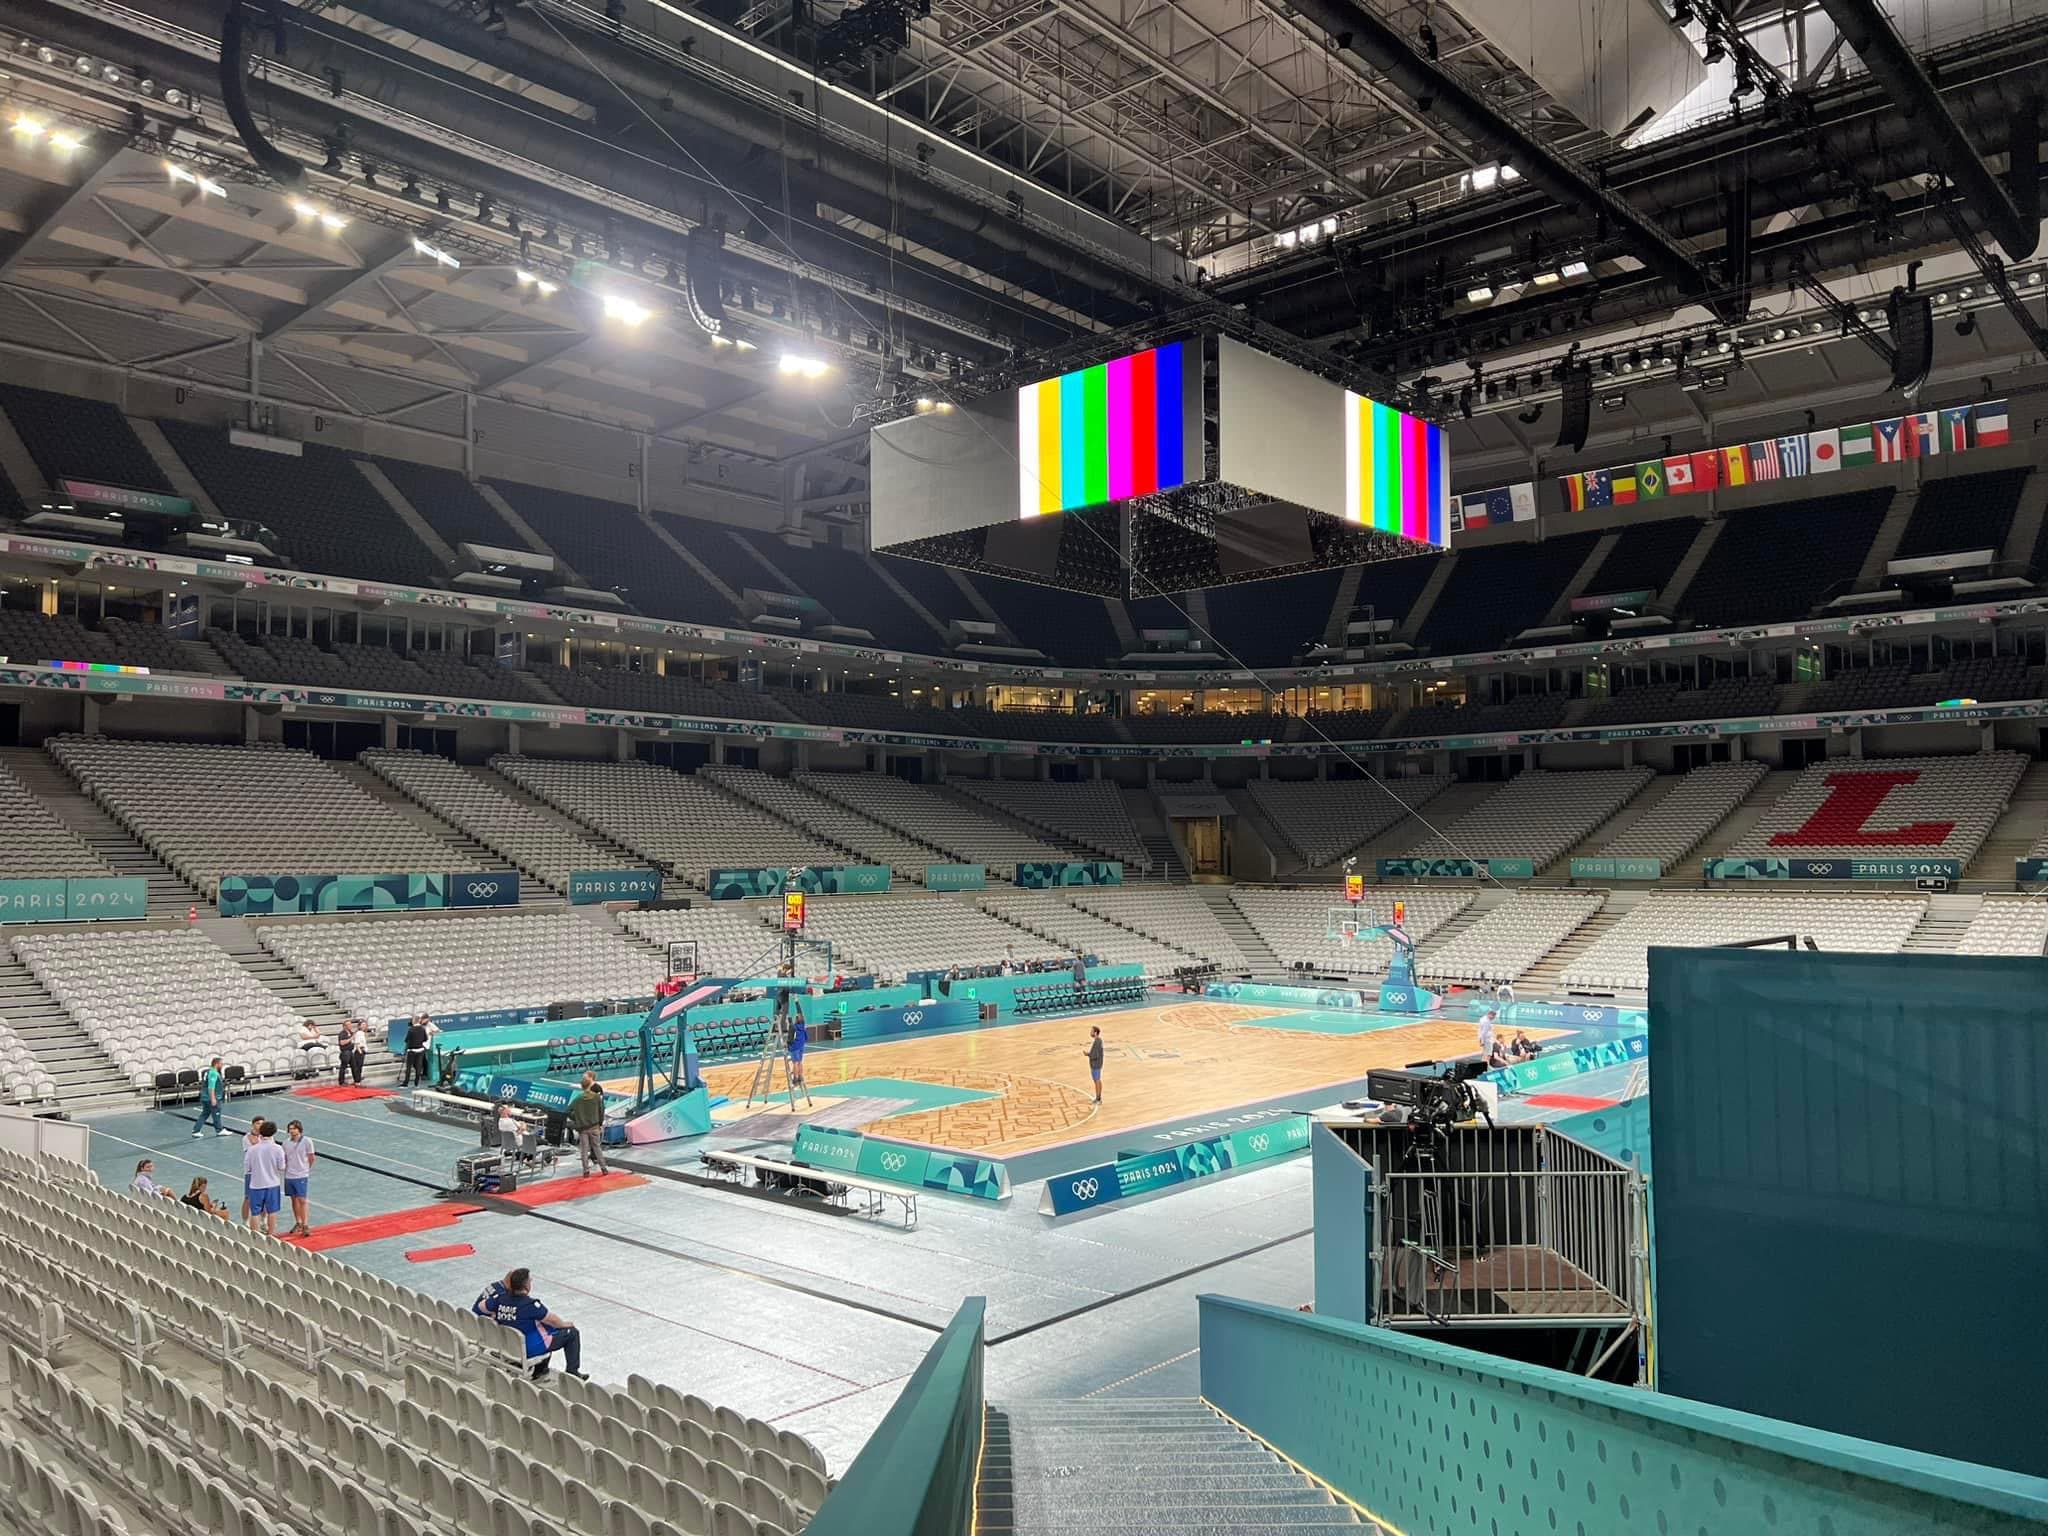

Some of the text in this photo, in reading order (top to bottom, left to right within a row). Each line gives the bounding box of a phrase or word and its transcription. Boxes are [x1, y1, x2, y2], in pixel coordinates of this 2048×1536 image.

[147, 684, 213, 697] PARIS 2024
[357, 697, 412, 709] PARIS 2024
[1933, 709, 1989, 719] PARIS 2024
[1768, 770, 1956, 847] L
[1579, 863, 1653, 873] PARIS 2024
[1859, 864, 1952, 875] PARIS 2024
[576, 880, 656, 893] PARIS 2024
[0, 892, 133, 908] PARIS 2024
[803, 1141, 856, 1160] PARIS 2024
[1123, 1161, 1178, 1184] PARIS 2024
[498, 1305, 518, 1314] PARIS
[498, 1312, 517, 1321] 2024
